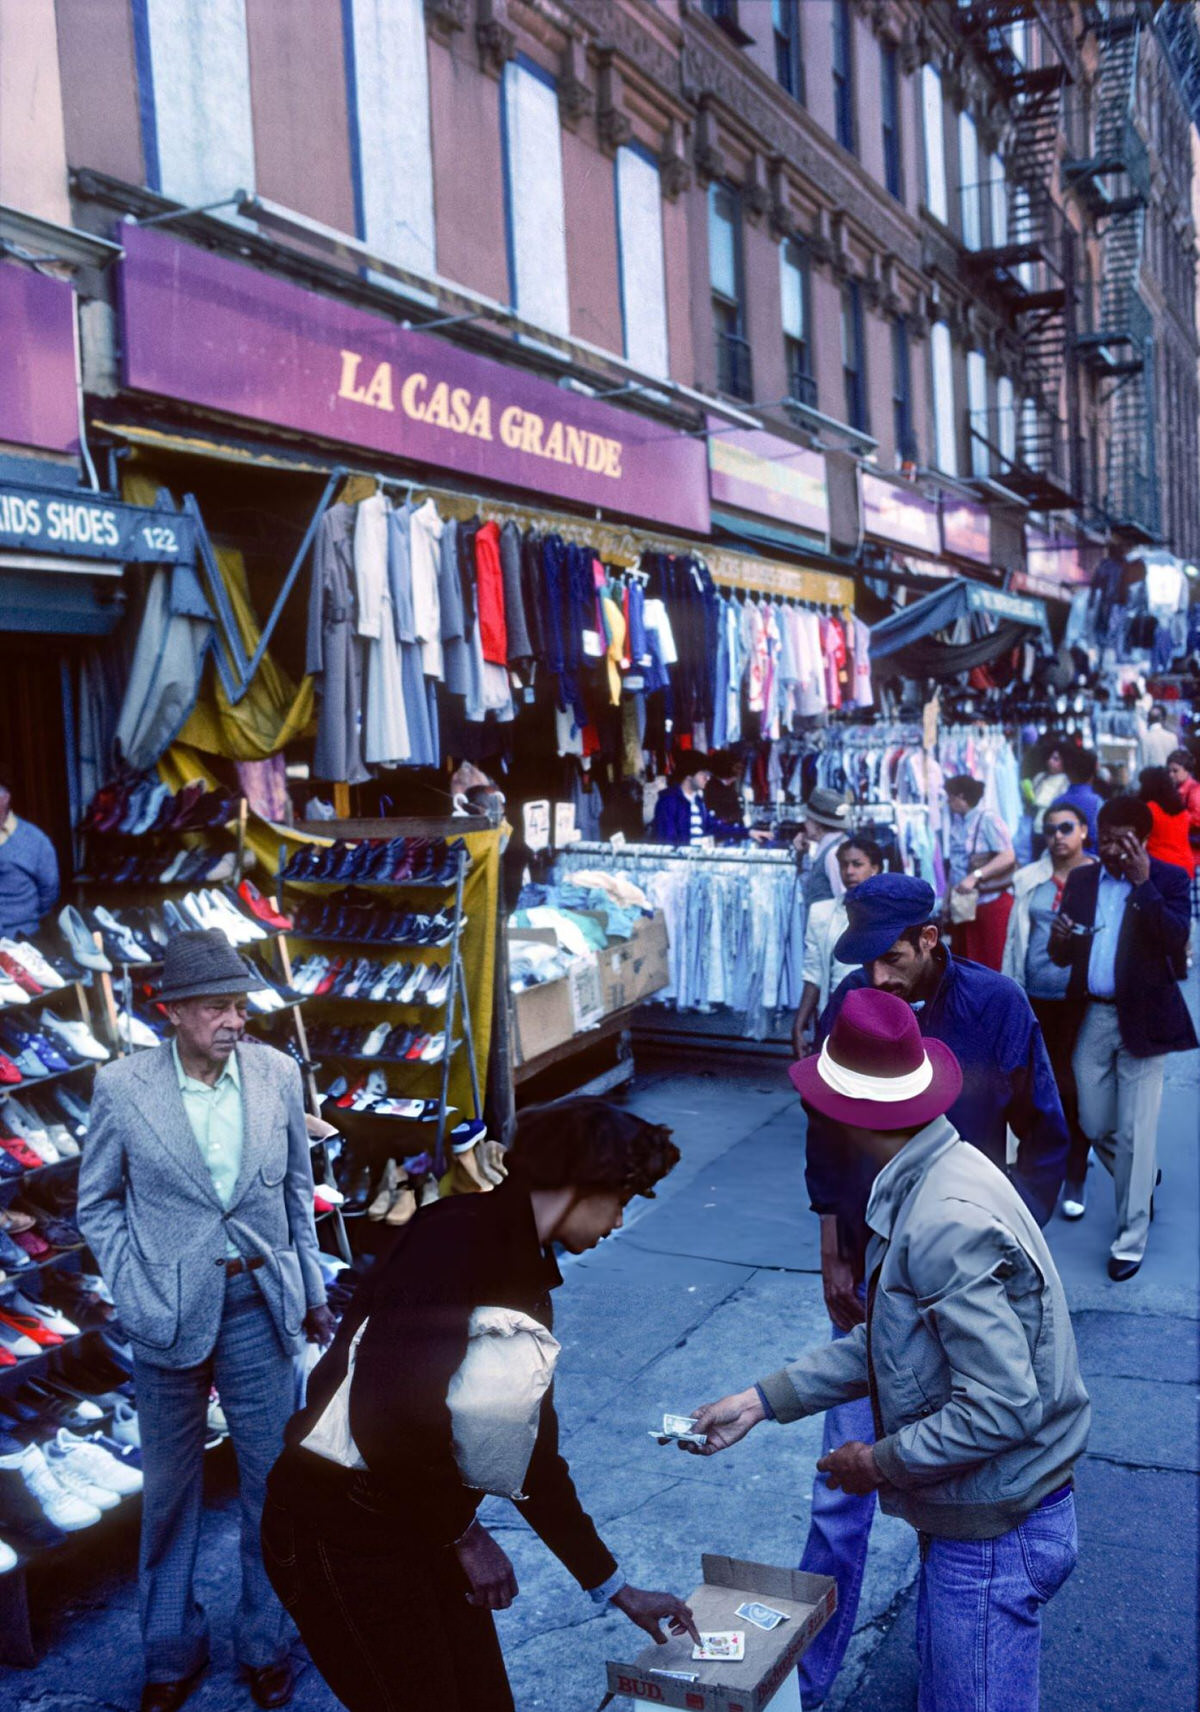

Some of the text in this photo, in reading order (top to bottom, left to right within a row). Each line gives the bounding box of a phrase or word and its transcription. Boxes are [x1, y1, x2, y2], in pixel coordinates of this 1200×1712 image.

[338, 350, 622, 480] LA CASA GRANDE
[46, 501, 120, 546] SHOES
[142, 526, 179, 553] 122
